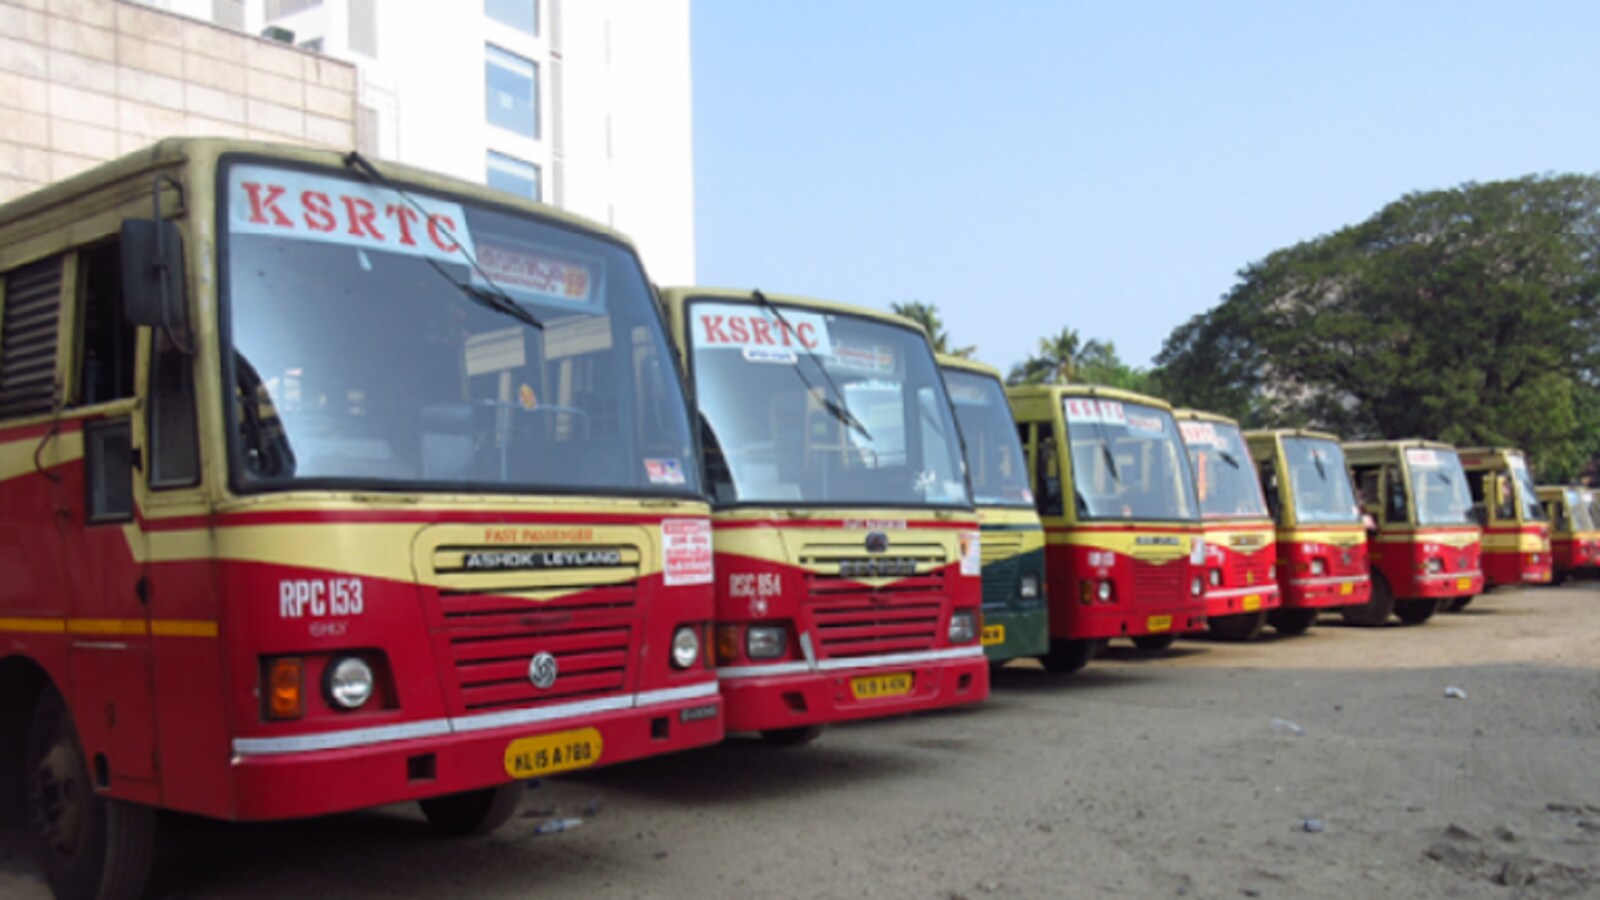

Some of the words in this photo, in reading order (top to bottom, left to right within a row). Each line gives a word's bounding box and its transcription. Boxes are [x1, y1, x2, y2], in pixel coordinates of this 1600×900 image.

[241, 181, 462, 254] KSRTC
[700, 314, 819, 350] KSRTC
[484, 528, 518, 543] FAST
[521, 528, 594, 542] PASSENGER
[466, 552, 534, 568] ASHOK
[542, 550, 621, 567] LEYLAND
[279, 579, 326, 618] RPC
[329, 577, 364, 616] 153
